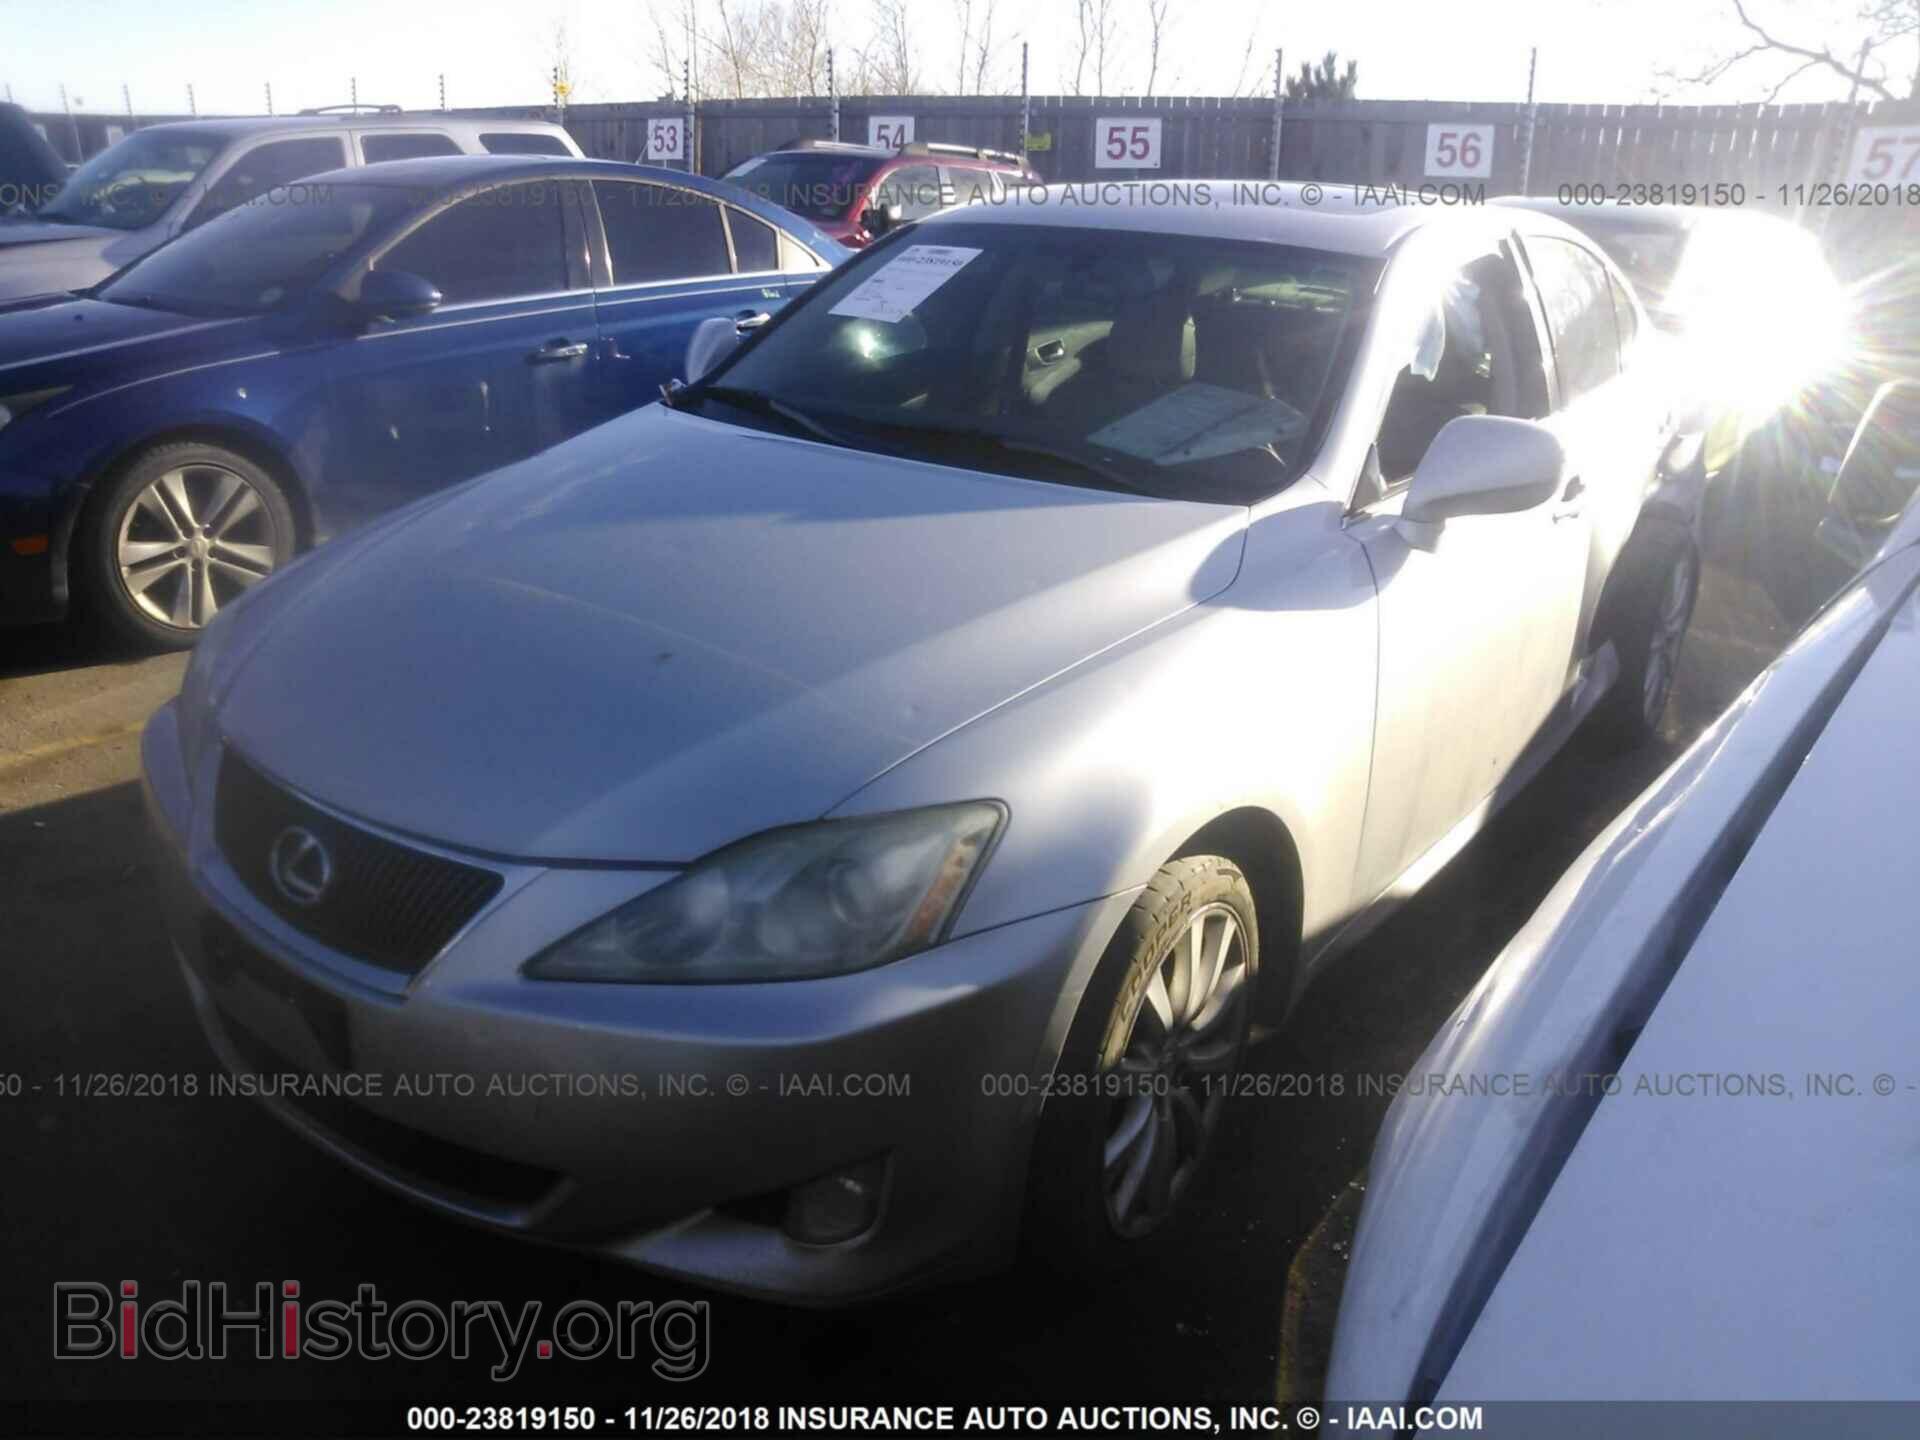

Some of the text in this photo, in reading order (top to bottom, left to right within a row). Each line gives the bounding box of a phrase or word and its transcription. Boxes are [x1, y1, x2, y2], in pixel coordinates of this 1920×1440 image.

[652, 125, 678, 152] 53
[876, 123, 905, 150] 54
[1106, 126, 1151, 161] 55
[1435, 131, 1482, 169] 56
[1861, 136, 1920, 179] 57
